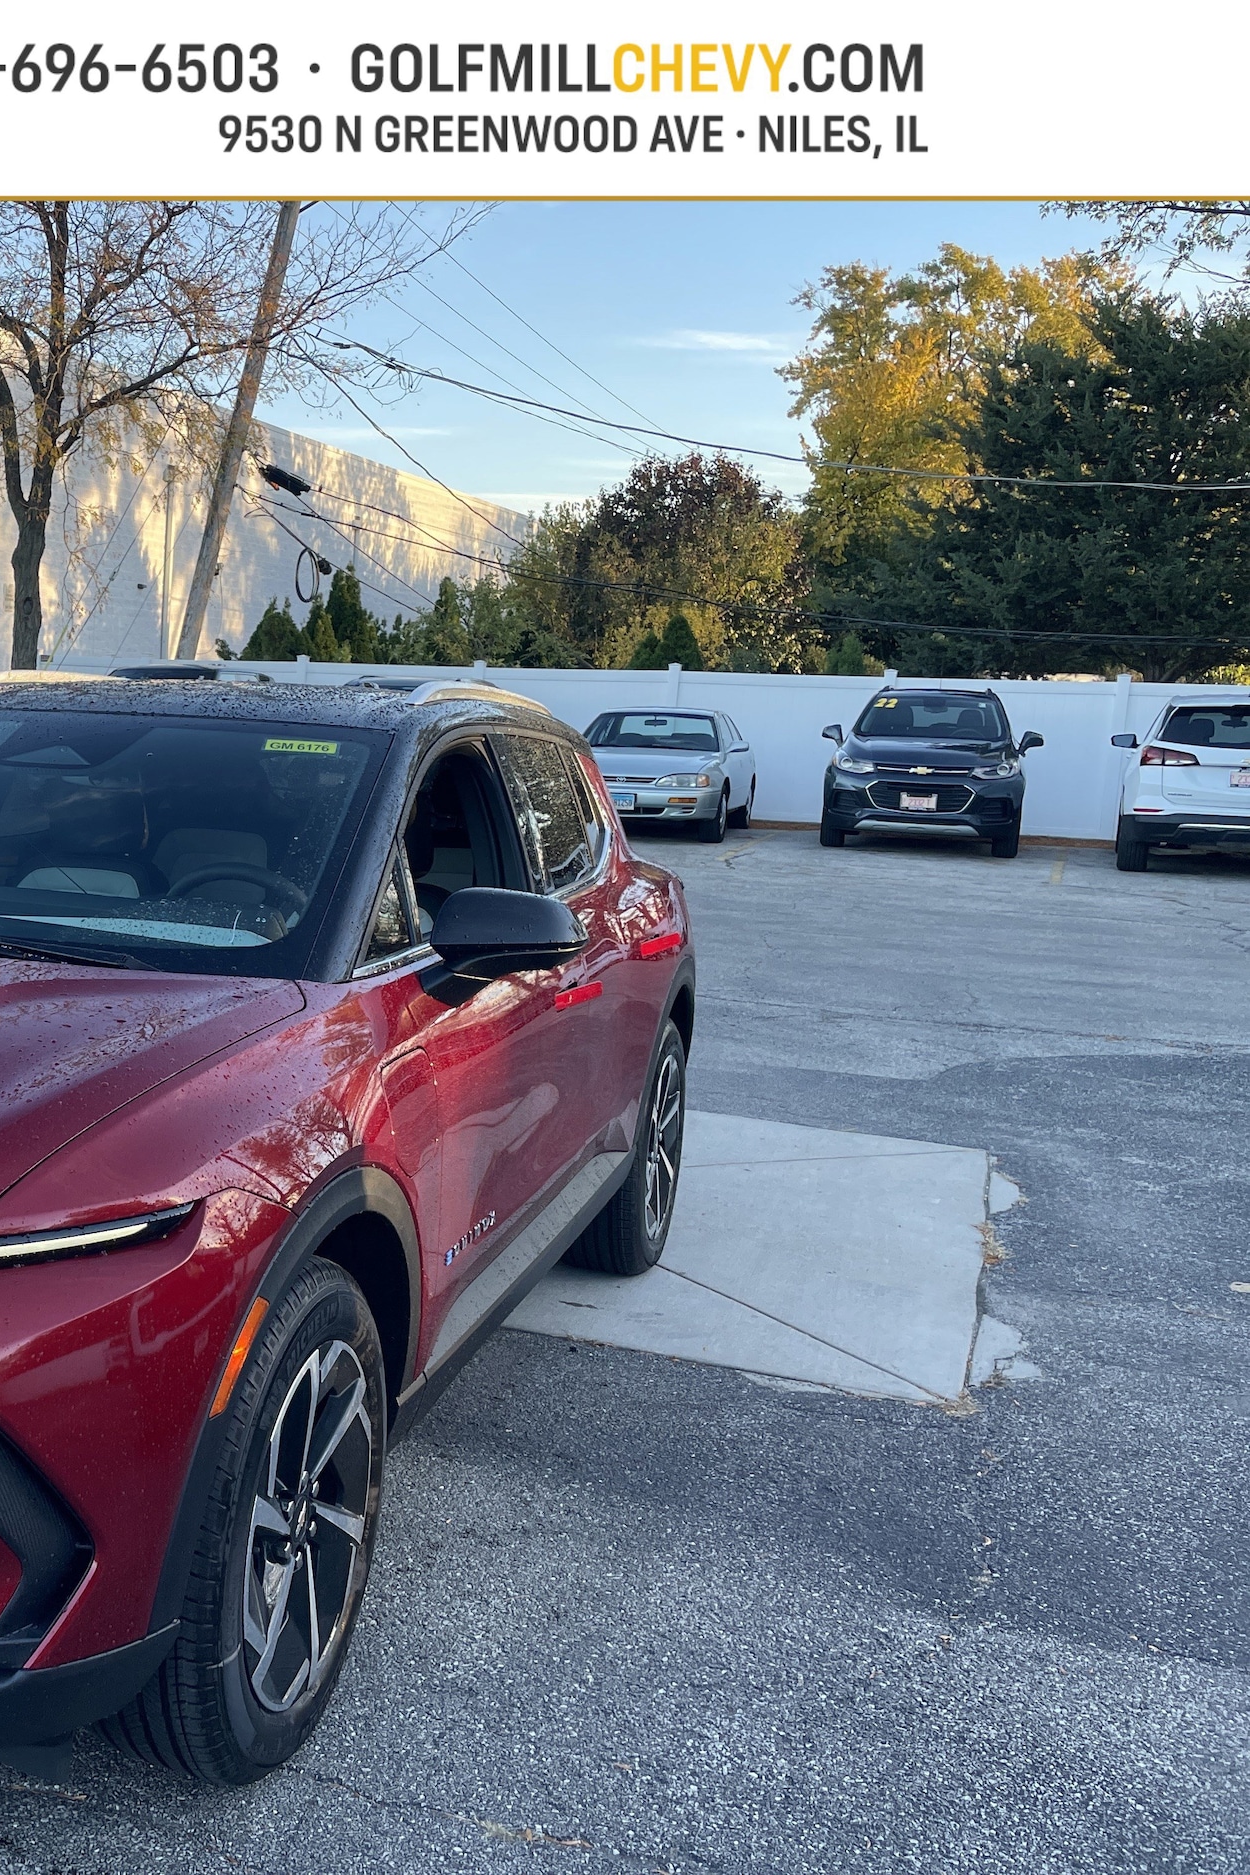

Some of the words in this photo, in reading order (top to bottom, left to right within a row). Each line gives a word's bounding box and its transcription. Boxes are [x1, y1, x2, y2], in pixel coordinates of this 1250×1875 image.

[874, 698, 898, 708] 22
[270, 742, 293, 750] GM
[297, 743, 330, 752] 6176
